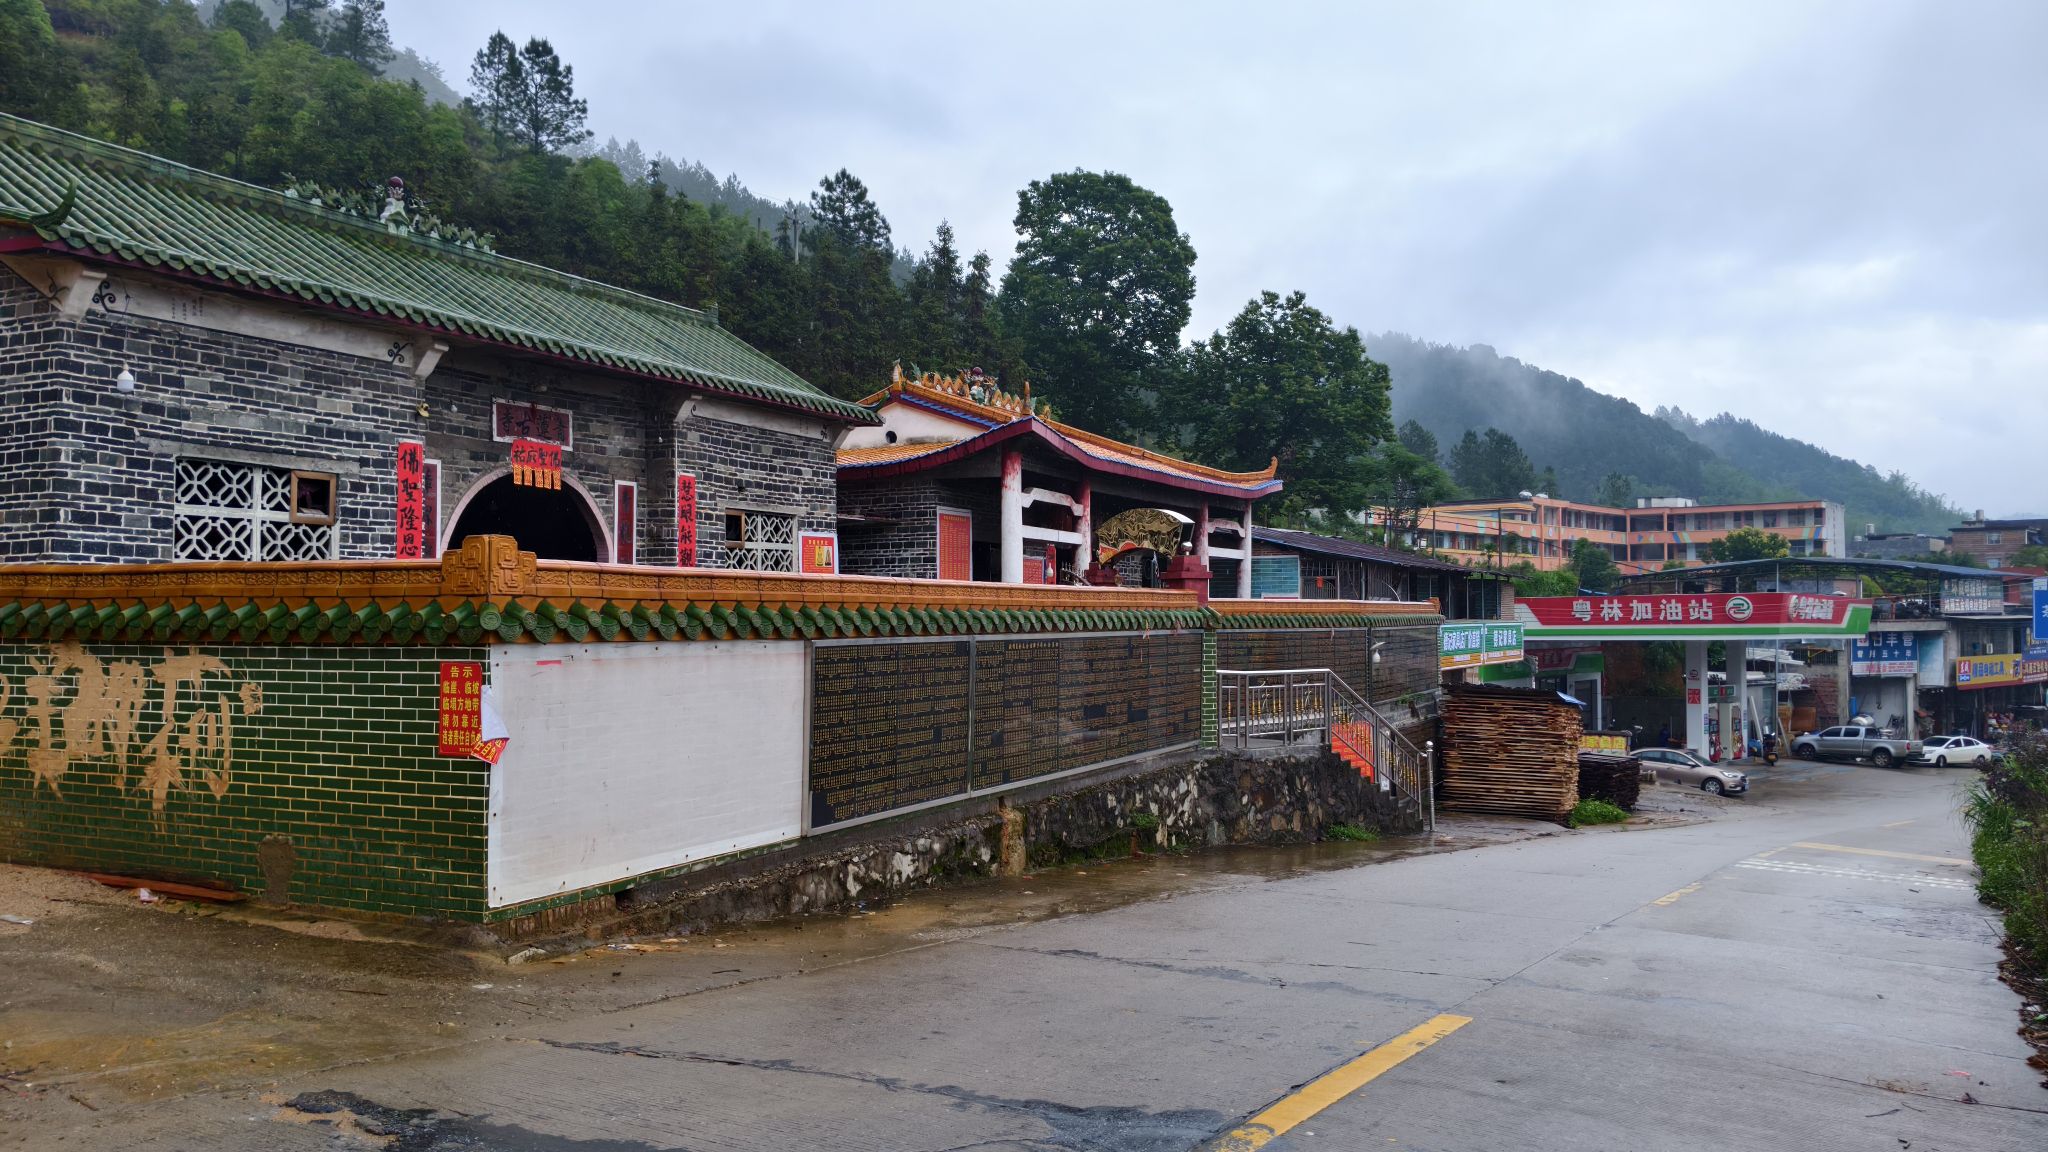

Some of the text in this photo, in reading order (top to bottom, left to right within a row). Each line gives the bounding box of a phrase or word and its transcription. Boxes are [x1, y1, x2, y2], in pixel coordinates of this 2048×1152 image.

[400, 446, 419, 556] 佛聖隆恩
[1571, 598, 1713, 621] 粤林加油站
[450, 666, 473, 678] 告示
[442, 681, 480, 695] 临崖、临坡
[442, 697, 480, 711] 临塌方地带
[442, 713, 479, 728] 请勿靠近
[442, 729, 476, 746] 违者责任自负
